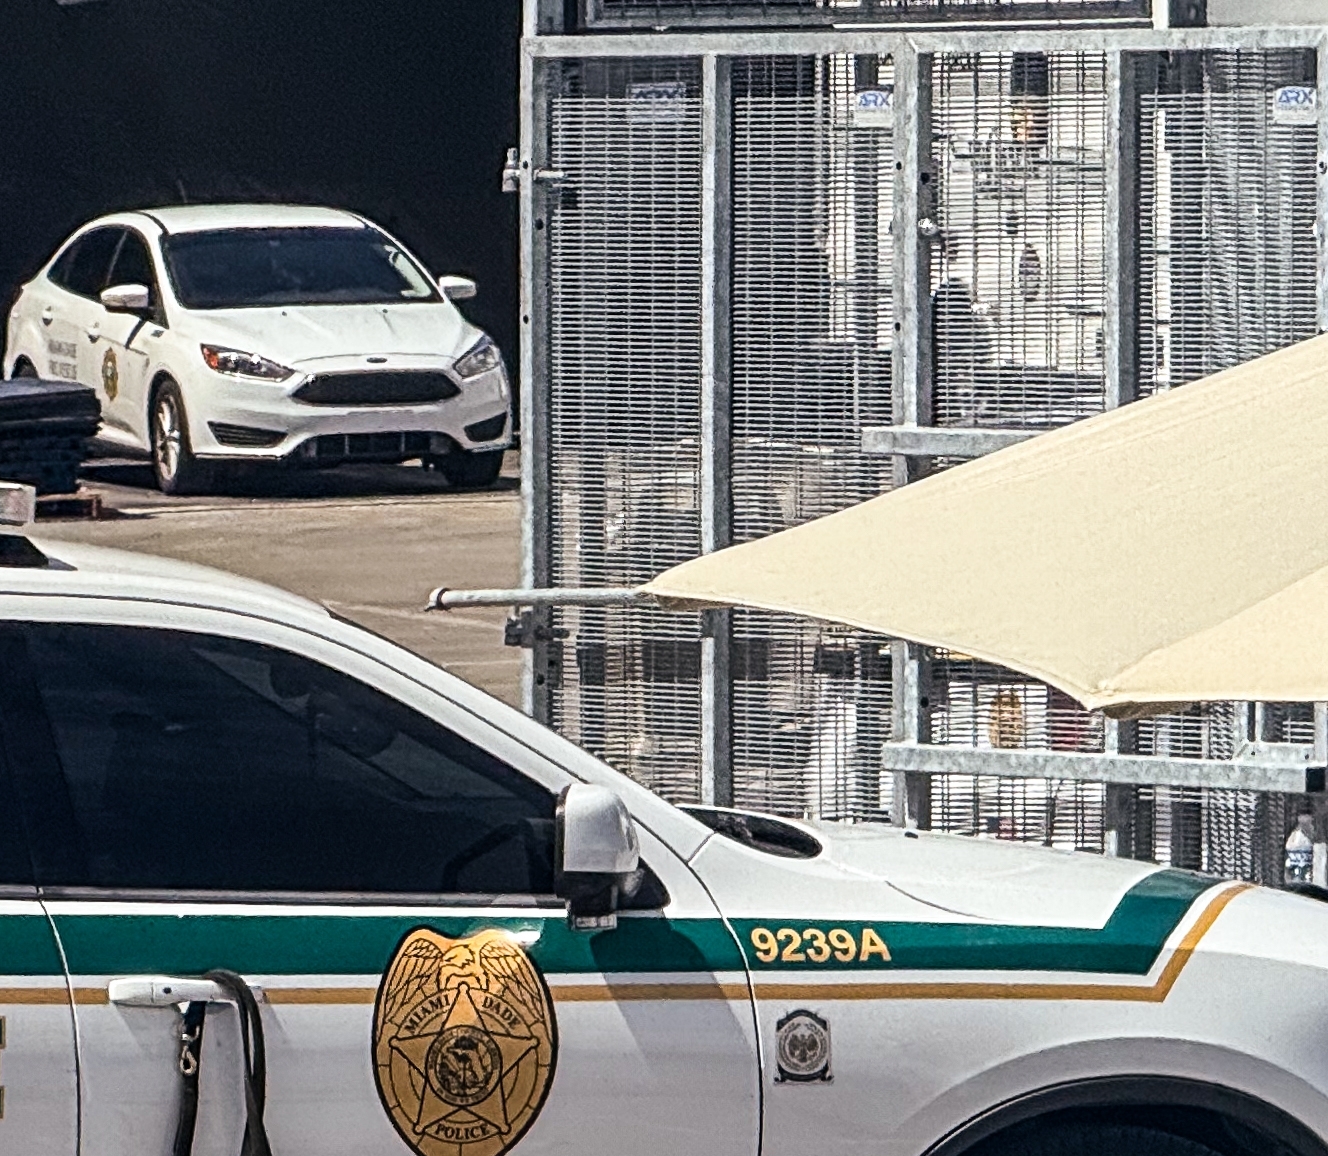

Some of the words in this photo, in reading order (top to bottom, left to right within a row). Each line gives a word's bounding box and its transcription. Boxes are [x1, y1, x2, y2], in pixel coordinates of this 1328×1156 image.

[750, 927, 892, 963] 9239A
[404, 994, 451, 1035] MIAMI
[481, 996, 524, 1029] DADE
[434, 1123, 490, 1139] POLICE
